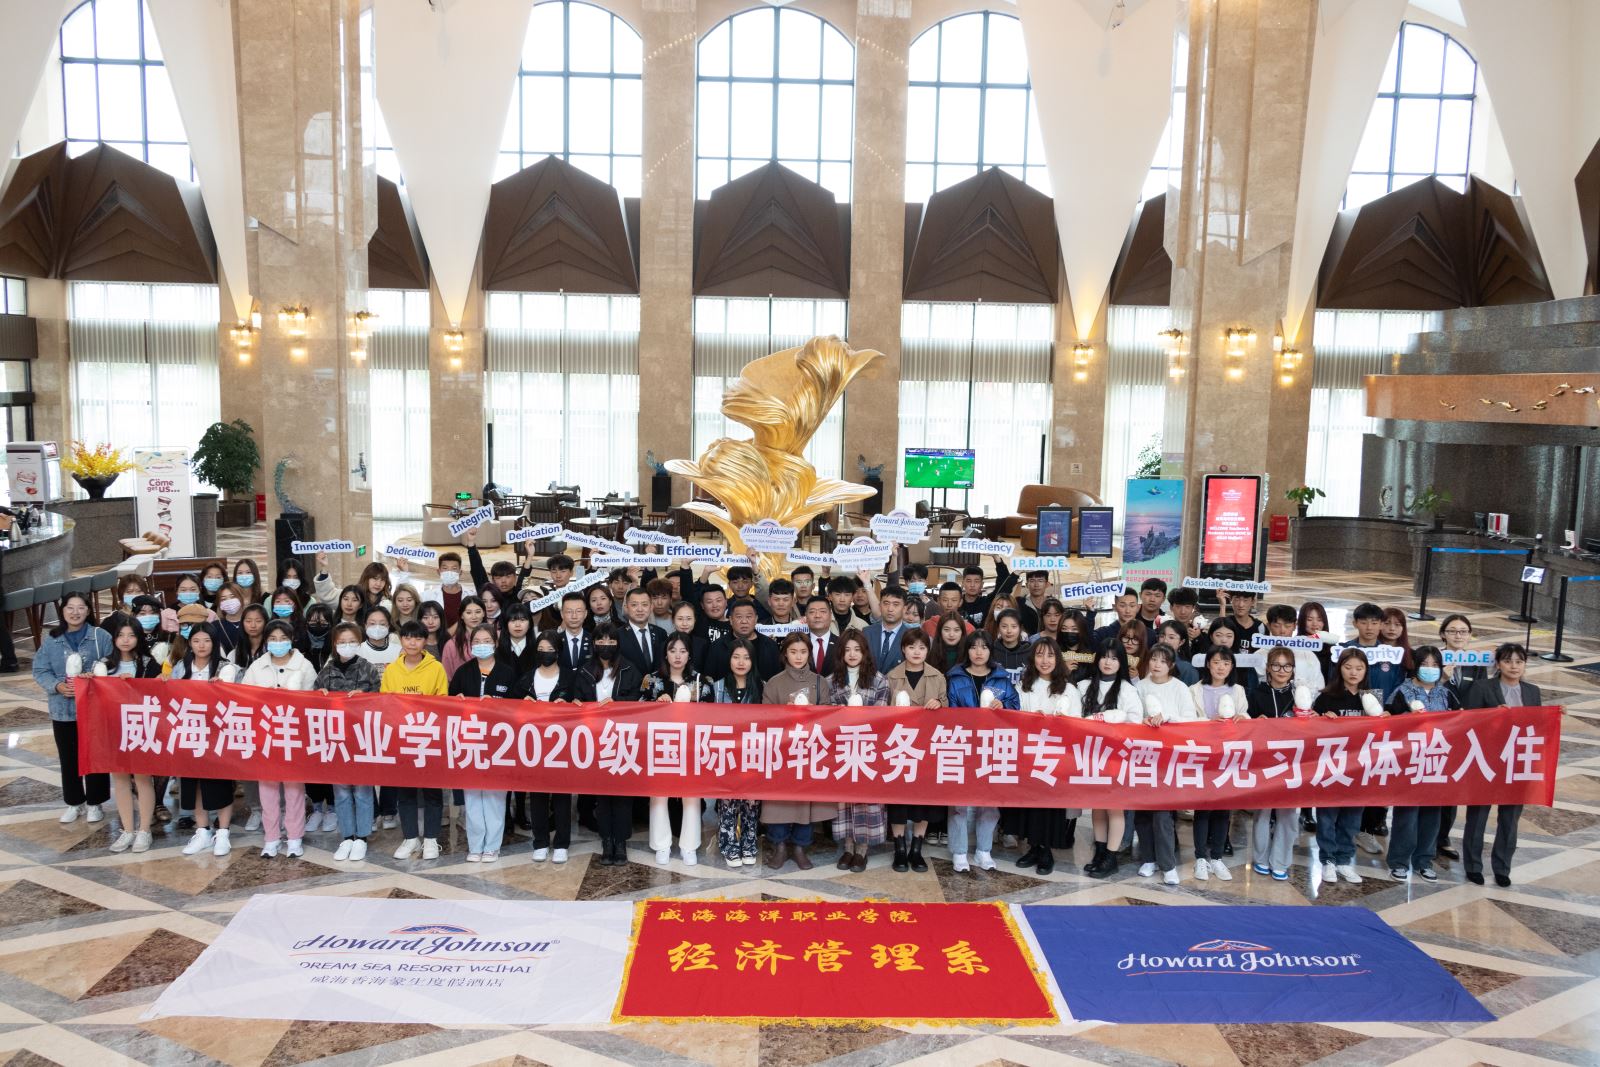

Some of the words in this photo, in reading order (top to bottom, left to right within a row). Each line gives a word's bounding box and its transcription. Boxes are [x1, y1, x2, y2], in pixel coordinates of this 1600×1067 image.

[450, 506, 493, 534] Integrity
[874, 517, 899, 526] Howard
[898, 518, 926, 528] Johnson
[508, 525, 560, 541] Dedication
[627, 530, 651, 542] Howard
[651, 533, 680, 544] Johnson
[743, 526, 768, 535] Howard
[766, 527, 794, 536] Johnson
[294, 542, 352, 550] Innovation
[566, 534, 588, 544] Passion
[588, 538, 598, 546] for
[598, 542, 631, 554] Excellence
[838, 545, 862, 554] Howard
[862, 544, 889, 554] Johnson
[961, 540, 1012, 554] Efficiency
[386, 546, 435, 558] Dedication
[666, 546, 722, 558] Efficiency
[790, 553, 822, 562] Resilience
[532, 590, 567, 610] Associate
[568, 582, 586, 593] Care
[586, 570, 606, 584] Week
[1064, 582, 1124, 598] Efficiency
[1185, 579, 1224, 588] Associate
[1246, 583, 1268, 591] Week
[1255, 636, 1320, 649] Innovation
[1336, 648, 1400, 660] Igrity
[119, 694, 1546, 790] 威海海洋职业学院2020级国际邮轮乘务管理专业酒店见习及体验入住
[658, 908, 918, 924] 威海海洋职业学院
[292, 934, 426, 952] Howard
[417, 936, 556, 956] Johnson
[667, 940, 991, 976] 经济管理系
[1117, 952, 1235, 970] Howard
[1240, 952, 1360, 972] Johnson
[300, 961, 357, 970] DREAM
[360, 962, 392, 971] SEA
[398, 964, 465, 972] RESORT
